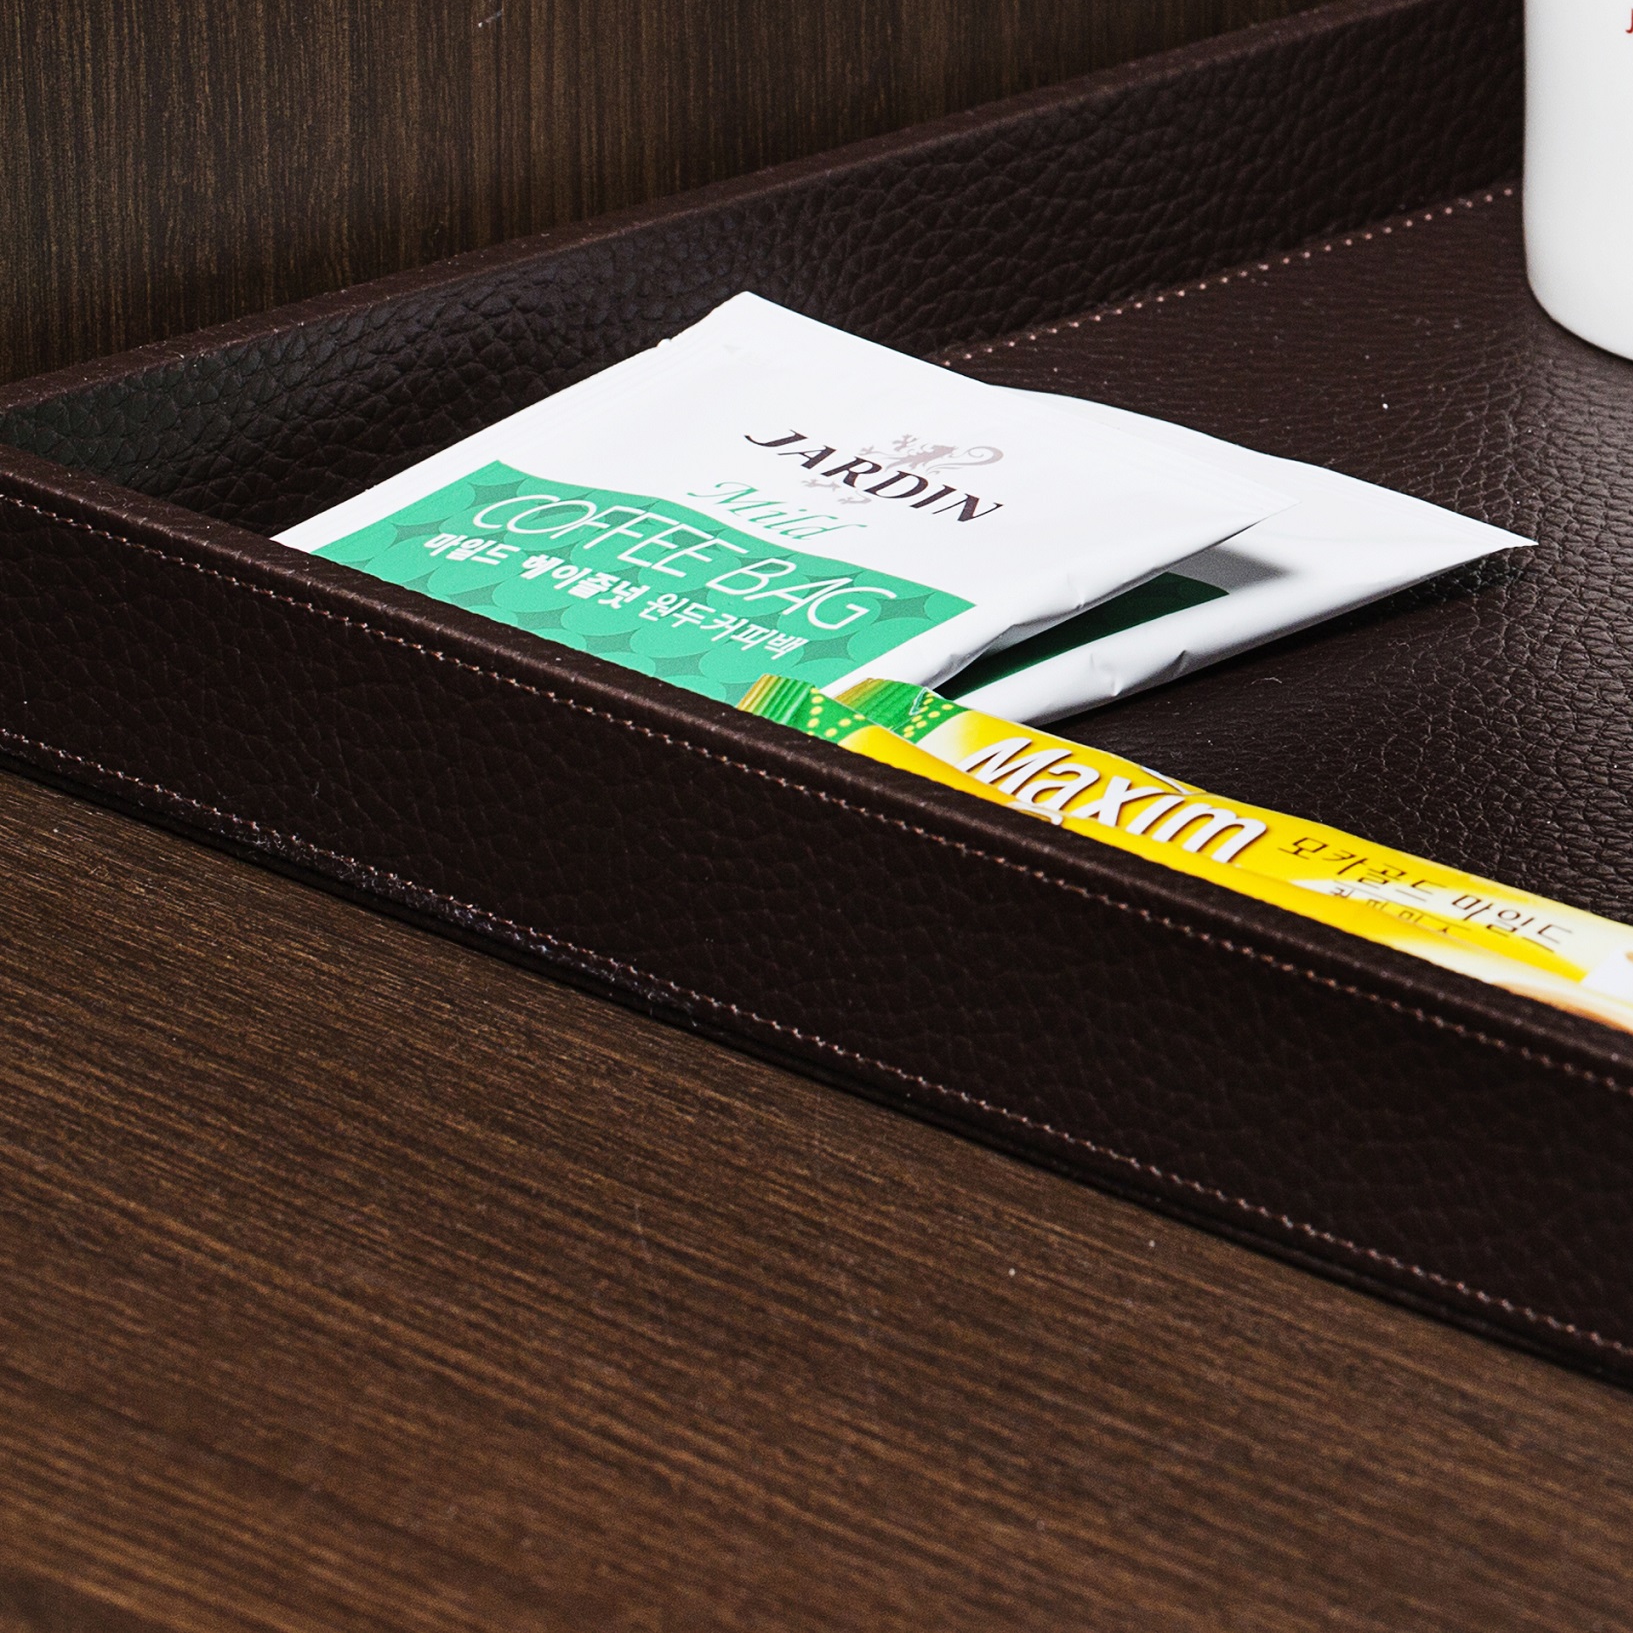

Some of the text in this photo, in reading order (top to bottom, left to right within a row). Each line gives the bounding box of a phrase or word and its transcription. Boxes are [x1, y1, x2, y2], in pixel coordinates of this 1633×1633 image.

[686, 480, 868, 541] Mild
[743, 429, 1004, 523] JARDIN
[423, 532, 521, 566] 마일드
[638, 592, 809, 660] 원두커피백
[472, 494, 897, 631] COFFEE BAG
[954, 736, 1267, 864] Maxim
[1277, 836, 1574, 953] 모카골드 마일드
